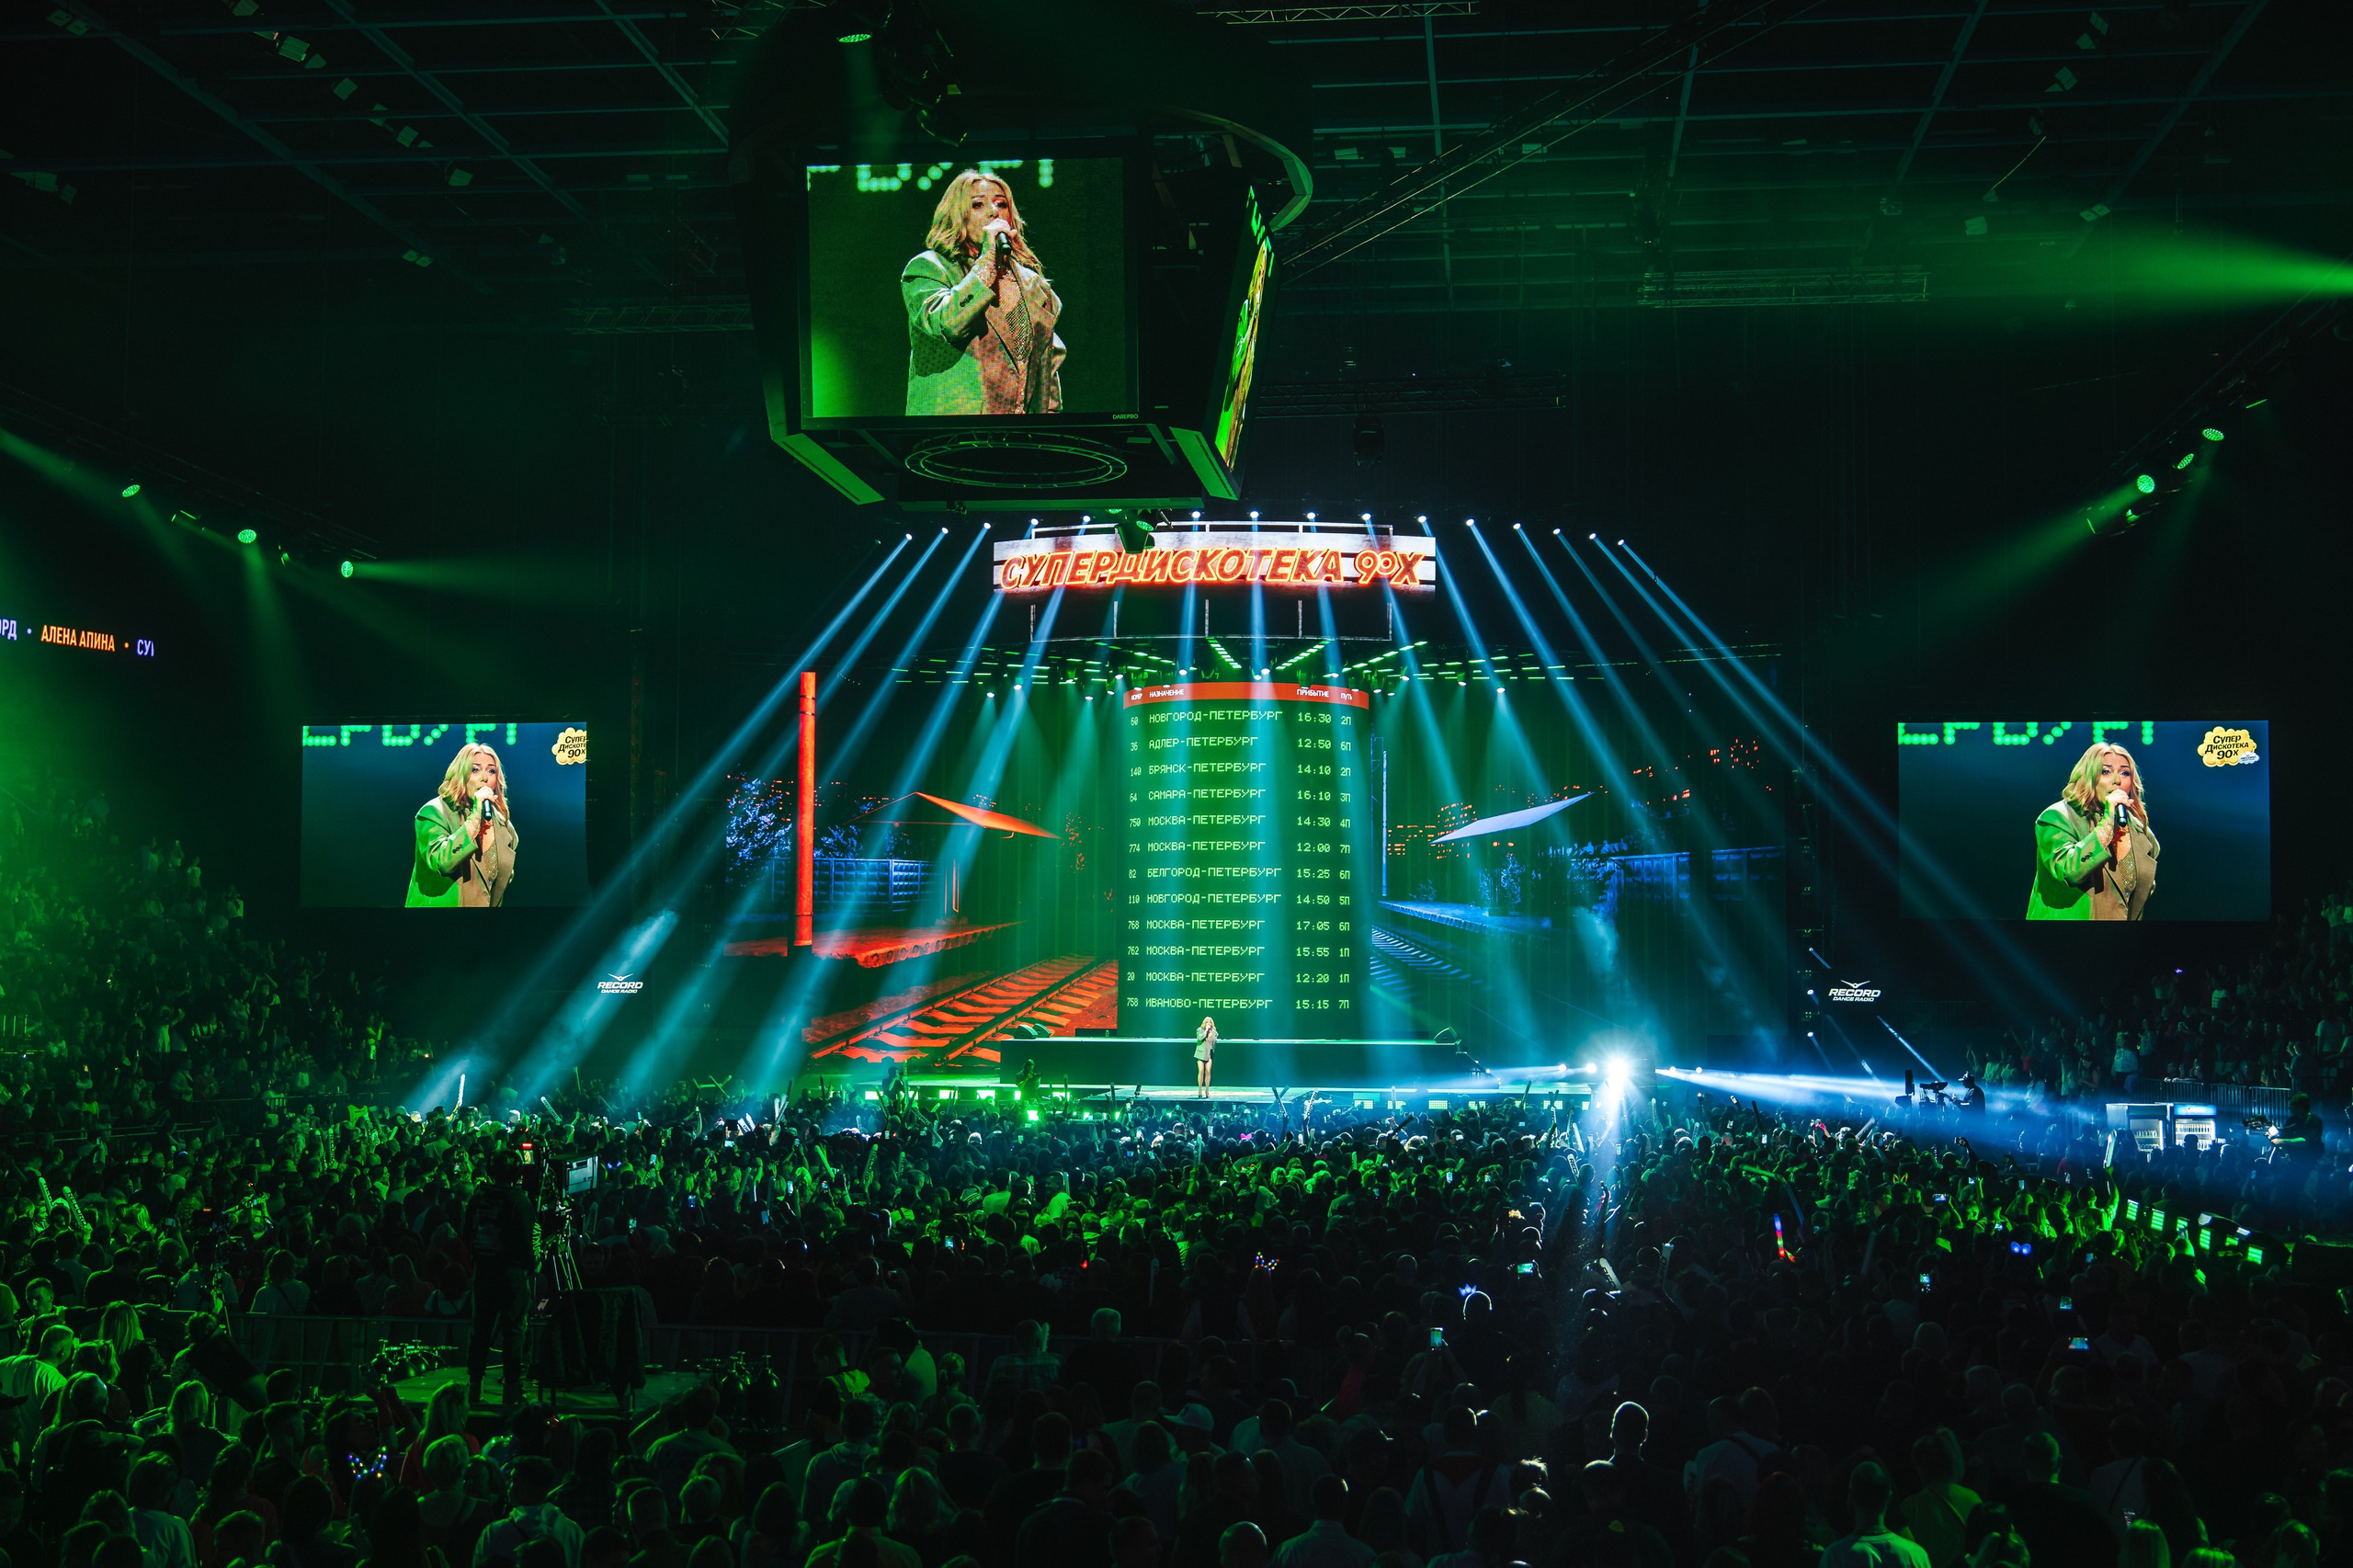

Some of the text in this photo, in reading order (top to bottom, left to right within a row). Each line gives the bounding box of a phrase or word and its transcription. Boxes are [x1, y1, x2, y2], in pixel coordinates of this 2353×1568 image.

[1000, 548, 1426, 590] СУПЕРДИСКОТЕКА 90Х
[40, 624, 77, 647] АЛЕНА
[78, 630, 116, 653] АПИНА
[1149, 688, 1185, 698] НАЗНАЧЕНИЕ
[1296, 688, 1330, 698] ПРИБЫТИЕ
[1340, 692, 1353, 700] ПУТЬ
[1131, 710, 1351, 725] 60 НОВГОРОД-ПЕТЕРБУРГ 16:30 2П
[1131, 737, 1351, 751] 36 АДЛЕР-ПЕТЕРБУРГ 12:50 6П
[1131, 763, 1350, 777] 140 БРЯНСК-ПЕТЕРБУРГ 14:10 2П
[1130, 789, 1350, 802] 64 САМАРА-ПЕТЕРБУРГ 16:10 3П
[1130, 815, 1350, 827] 750 МОСКВА-ПЕТЕРБУРГ 14:30 4П
[1130, 841, 1350, 853] 774 МОСКВА-ПЕТЕРБУРГ 12:00 7П
[1129, 868, 1350, 880] 82 БЕЛГОРОД-ПЕТЕРБУРГ 15:25 6П
[1129, 893, 1349, 905] 110 НОВГОРОД-ПЕТЕРБУРГ 14:50 5П
[1128, 920, 1349, 931] 768 МОСКВА-ПЕТЕРБУРГ 17:05 6П
[1128, 946, 1349, 957] 762 МОСКВА-ПЕТЕРБУРГ 15:55 1П
[1127, 971, 1349, 983] 20 МОСКВА-ПЕТЕРБУРГ 12:20 1П
[597, 981, 644, 990] RECORD
[1828, 988, 1881, 998] RECORD
[1127, 997, 1349, 1009] 758 ИВАНОВО-ПЕТЕРБУРГ 15:15 7П
[67, 1192, 88, 1227] RECORD
